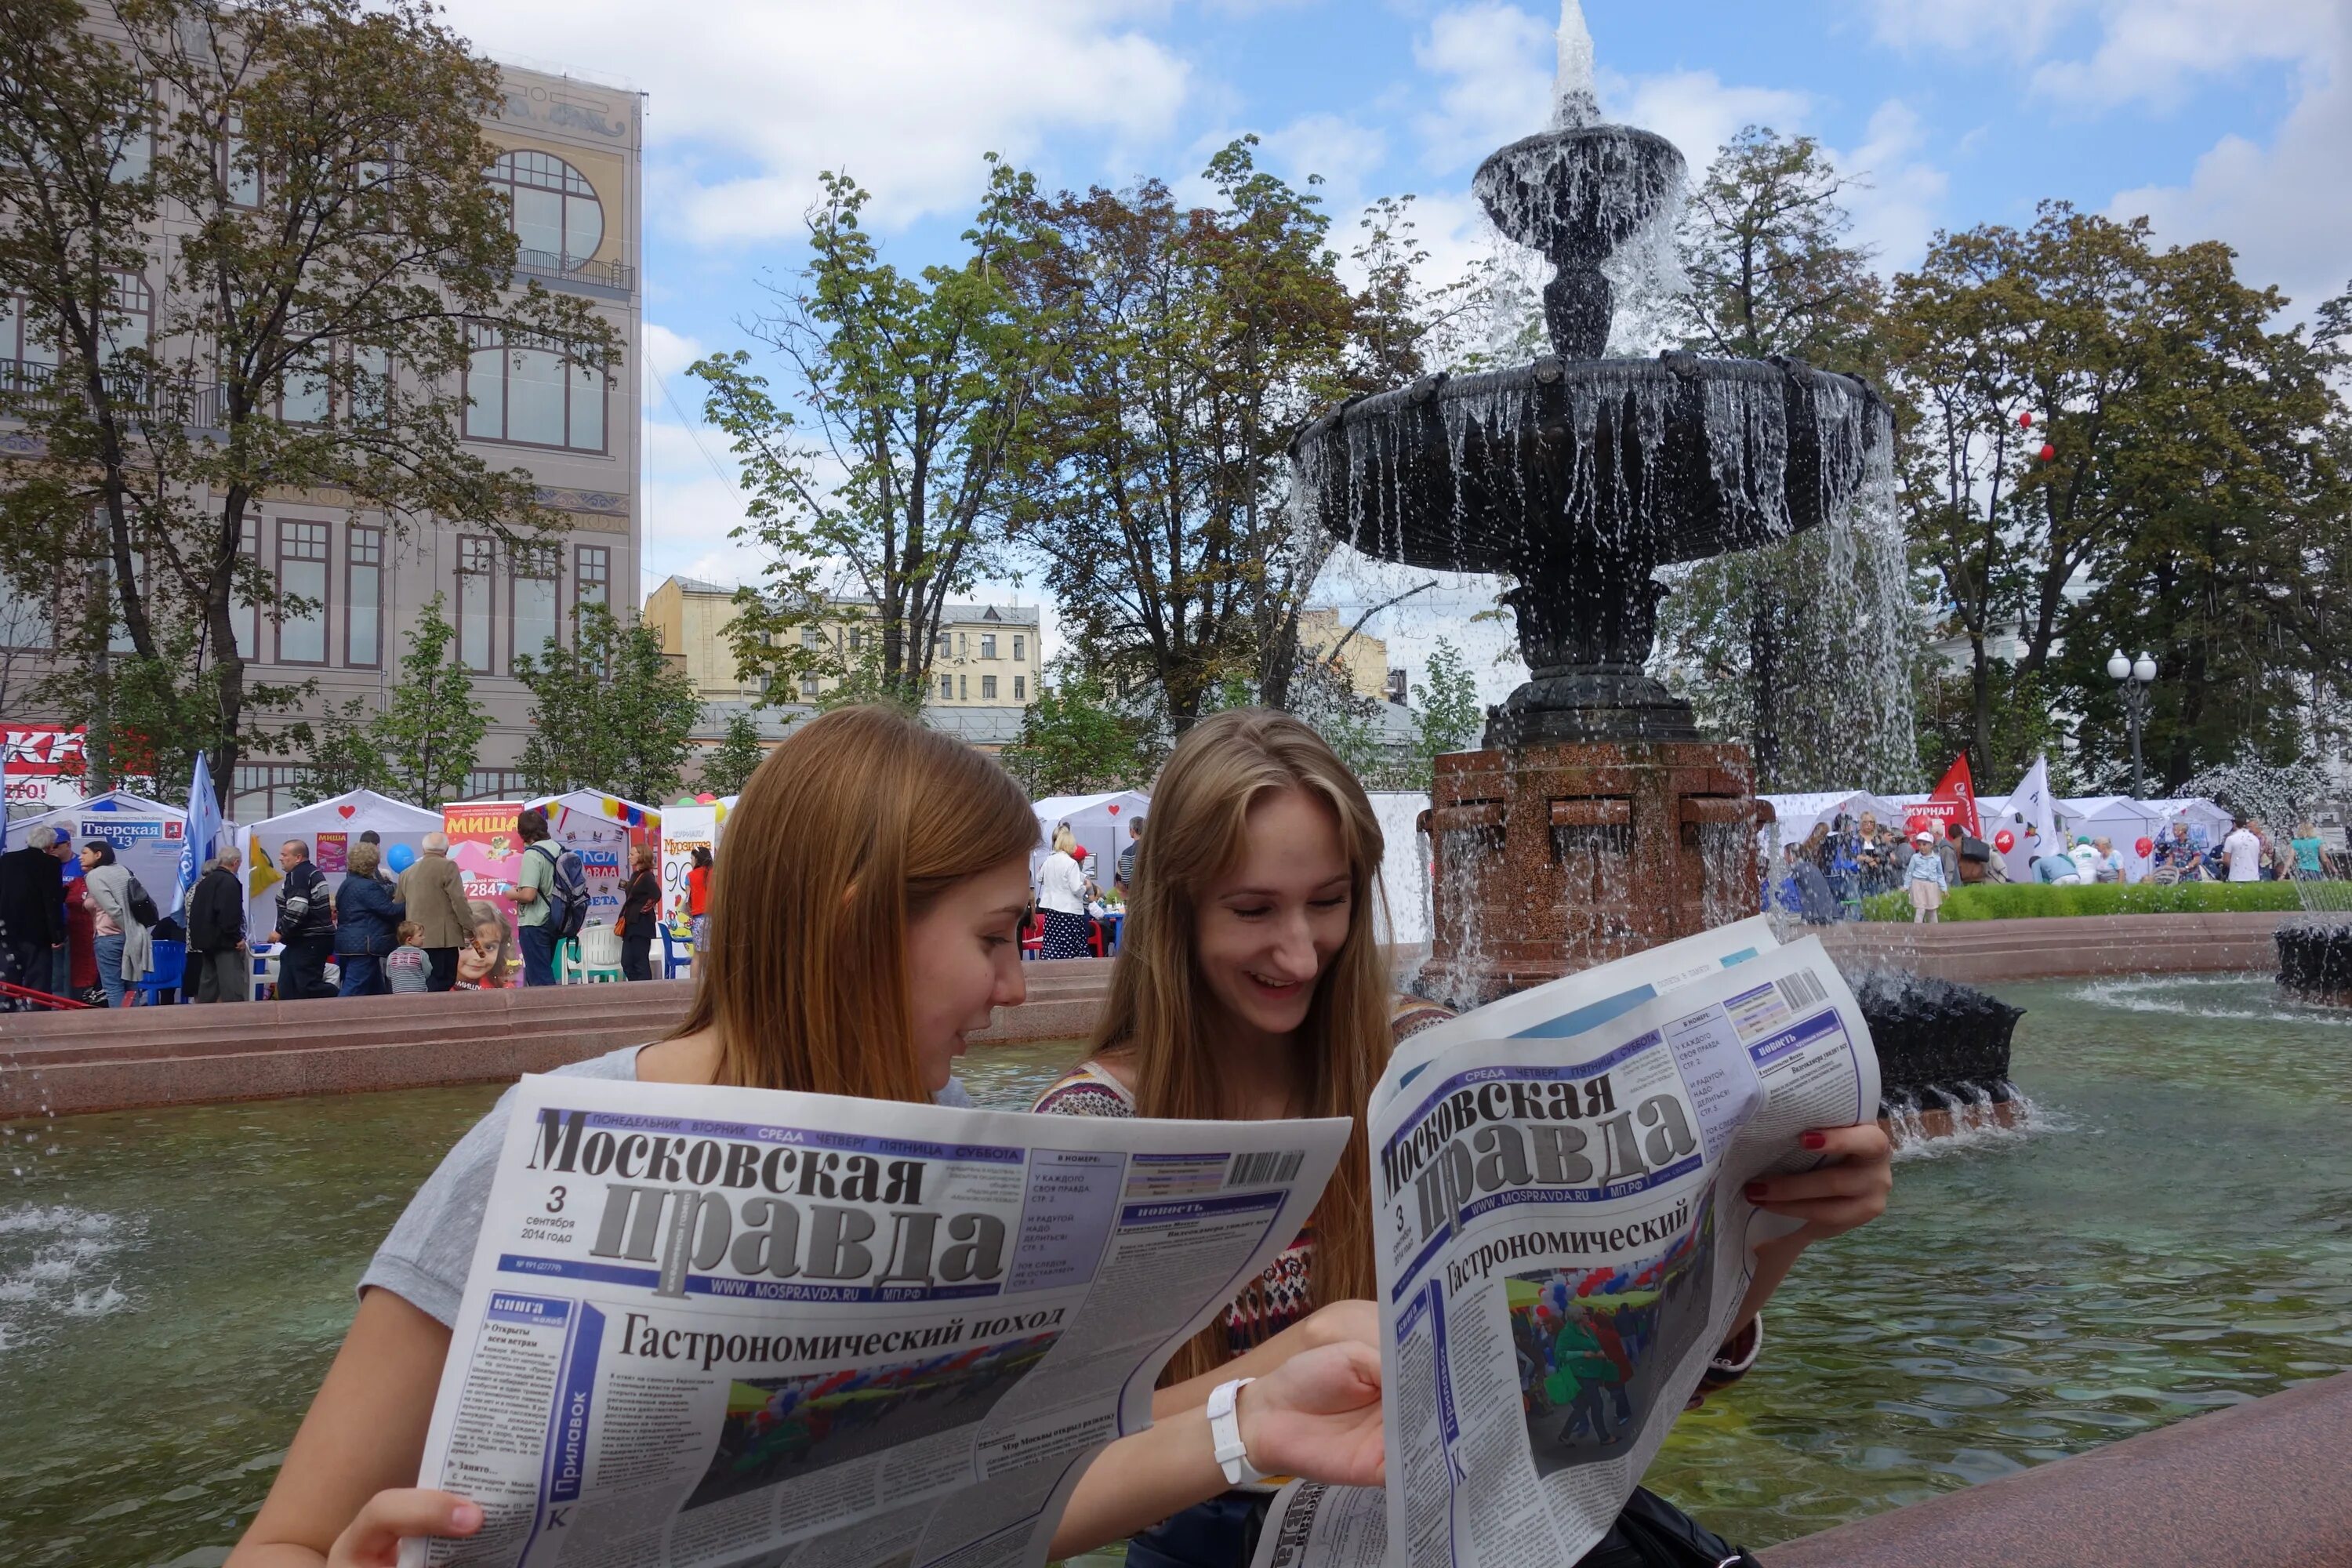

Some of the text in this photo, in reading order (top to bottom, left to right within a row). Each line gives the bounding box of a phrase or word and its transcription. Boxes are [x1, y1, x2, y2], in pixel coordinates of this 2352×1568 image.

[4, 731, 89, 763] KF
[83, 823, 158, 837] Тверская
[447, 816, 517, 833] МИША
[118, 837, 132, 847] 13
[463, 883, 505, 896] 72847
[1681, 1033, 1711, 1048] КАЖДОГО
[1465, 1034, 1658, 1083] СРЕДА ЧЕТВЕРГ ПЯТНИЦА СУББОТА
[1679, 1049, 1697, 1060] СВОЯ
[1791, 1055, 1823, 1074] Видеокамера
[1823, 1047, 1839, 1061] увидит
[1697, 1069, 1725, 1085] РАДУГОЙ
[1694, 1086, 1712, 1097] НАДО
[1697, 1089, 1730, 1109] ДЕЛИТЬСЯ!
[1700, 1108, 1713, 1116] СТР.
[592, 1113, 1018, 1160] ПОНЕДЕЛЬНИК ВТОРНИК СРЕДА ЧЕТВЕРГ ПЯТНИЦА СУББОТА
[1381, 1073, 1617, 1209] Московская
[526, 1108, 927, 1205] Московская
[1414, 1094, 1697, 1243] правда
[546, 1185, 567, 1213] 3
[1610, 1179, 1644, 1200] МП.РФ
[679, 1193, 691, 1226] газета
[1396, 1204, 1404, 1232] 3
[526, 1216, 575, 1229] сентября
[1167, 1225, 1224, 1238] Видеокамера
[1225, 1221, 1254, 1231] увидит
[521, 1228, 572, 1243] 2014 года
[589, 1183, 1006, 1300] правда
[1446, 1196, 1689, 1301] Гастрономический
[882, 1287, 920, 1301] МП.РФ
[494, 1298, 544, 1314] книга
[492, 1324, 530, 1335] Открыты
[619, 1306, 1065, 1371] Гастрономический поход
[488, 1335, 537, 1348] всем ветрам
[1440, 1344, 1455, 1434] Прилавок
[555, 1391, 587, 1493] Прилавок
[1002, 1413, 1115, 1452] Мэр Москвы открыл развязку
[1451, 1445, 1468, 1487] К
[547, 1505, 572, 1530] К
